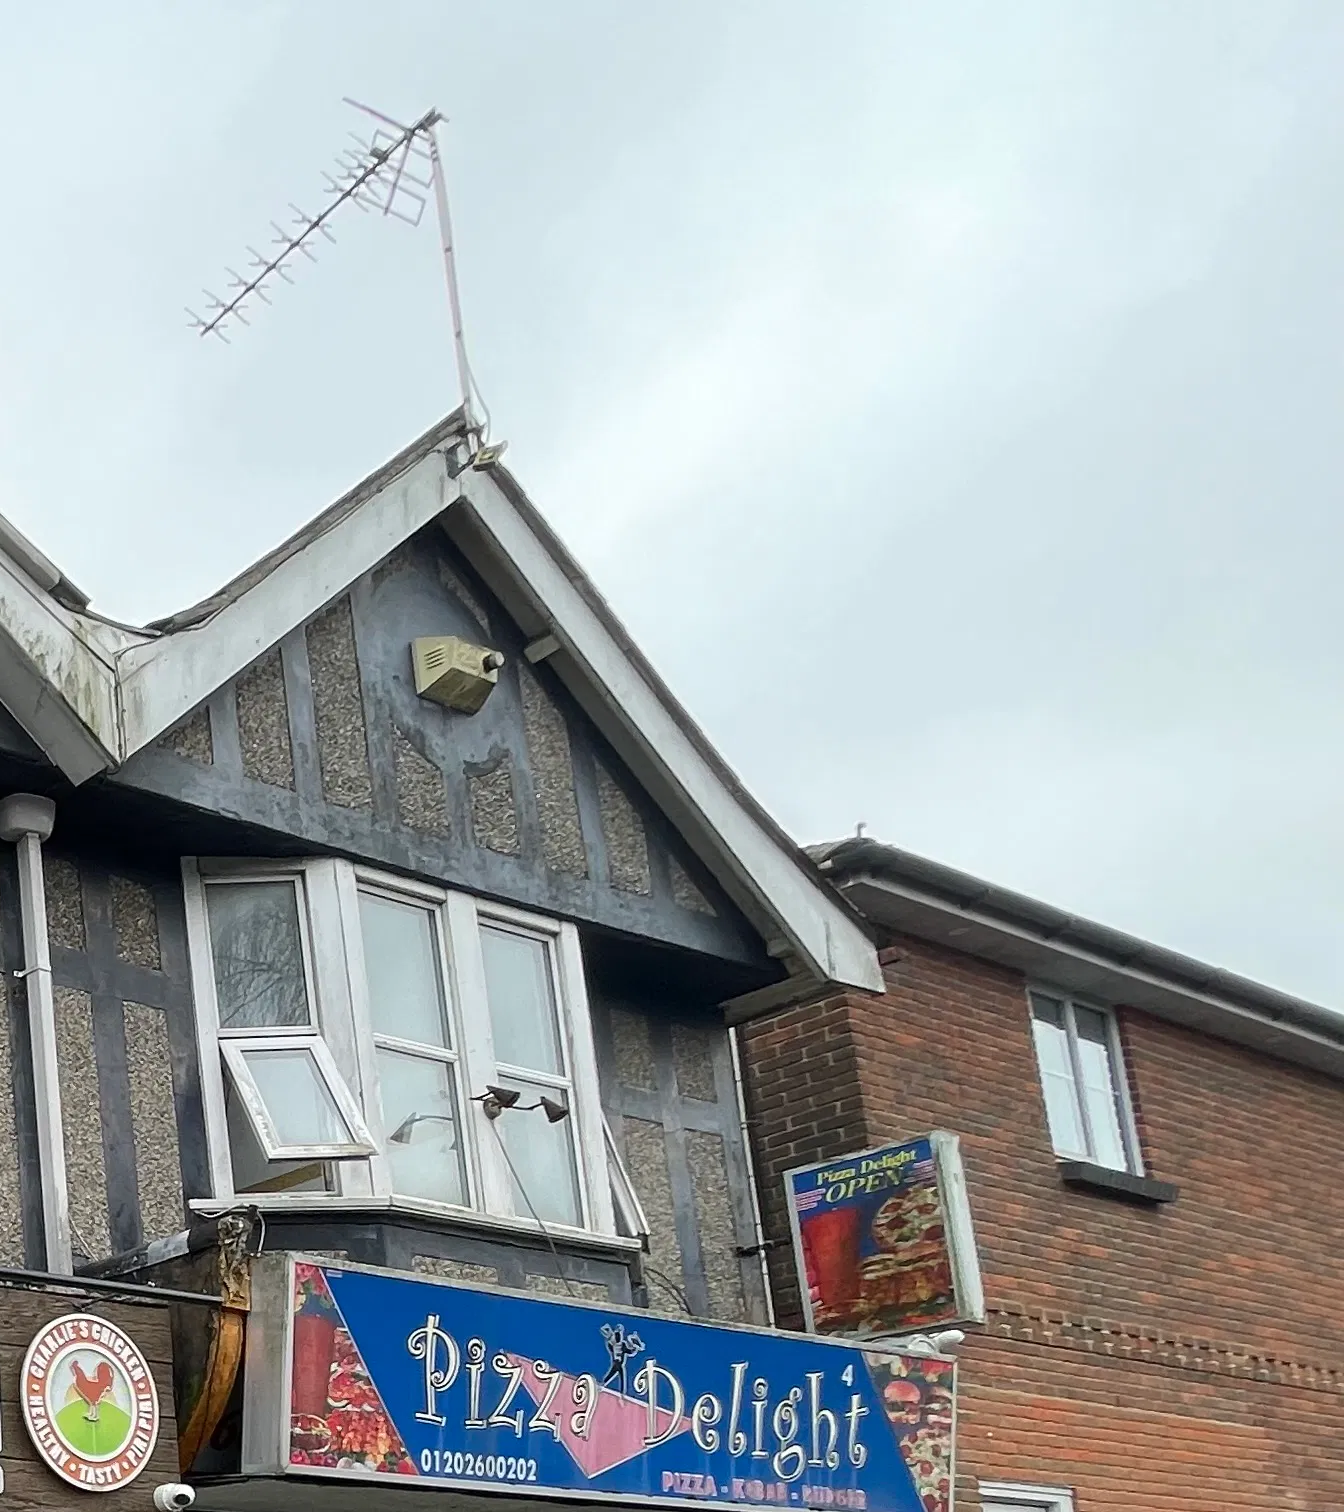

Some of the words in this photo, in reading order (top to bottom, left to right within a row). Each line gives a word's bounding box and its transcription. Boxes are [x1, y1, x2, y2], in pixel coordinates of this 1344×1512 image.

[817, 1168, 856, 1185] Pizza
[859, 1150, 917, 1173] Delight
[825, 1167, 904, 1203] OPEN
[30, 1320, 89, 1379] CHARLIE'S
[91, 1323, 145, 1382] CHICKEN
[841, 1365, 855, 1388] 4
[407, 1314, 598, 1442] Pizza
[634, 1358, 869, 1481] Delight
[29, 1395, 70, 1467] HEALTHY
[126, 1430, 149, 1467] PIRI
[138, 1393, 153, 1431] PIRI
[78, 1462, 122, 1485] TASTY
[421, 1448, 538, 1482] 01202600202
[662, 1471, 717, 1496] PIZZA
